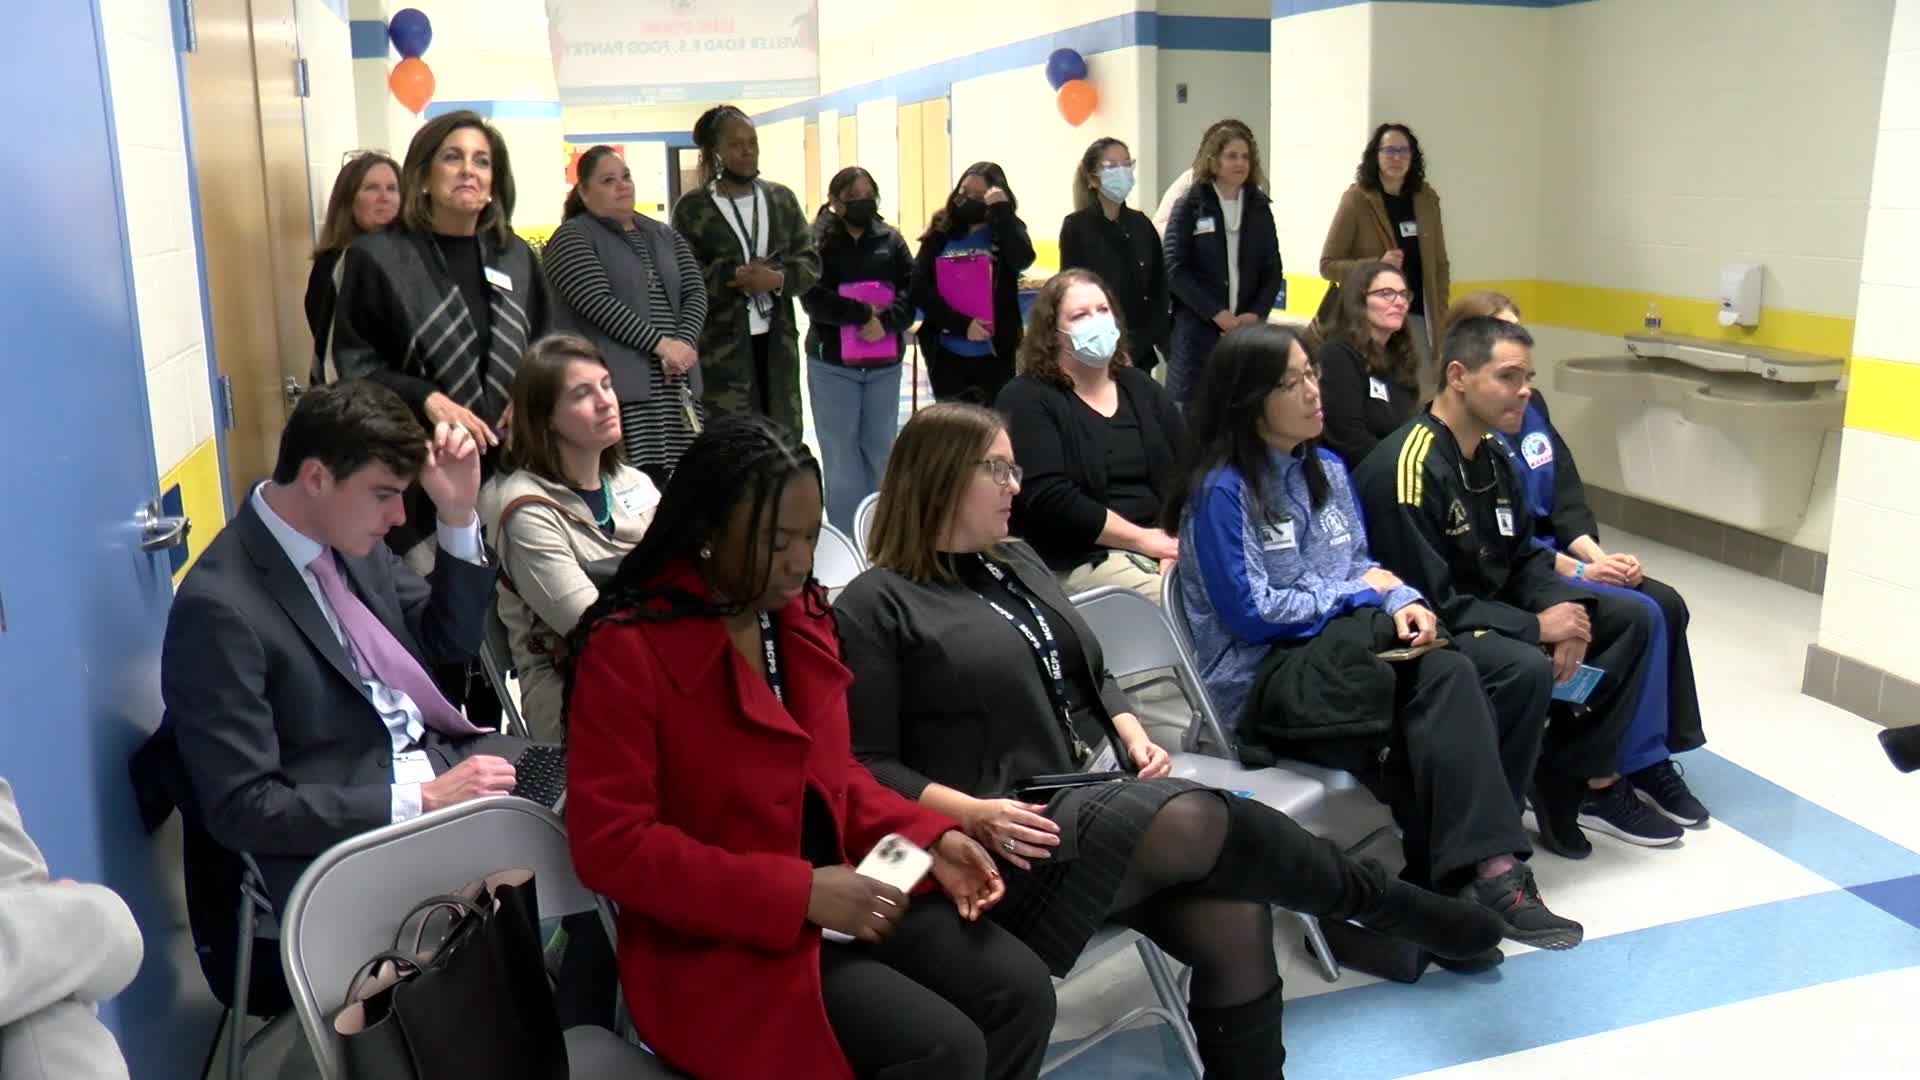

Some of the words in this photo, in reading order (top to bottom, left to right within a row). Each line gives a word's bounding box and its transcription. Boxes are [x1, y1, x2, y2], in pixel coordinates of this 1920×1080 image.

[1018, 623, 1041, 649] MCPS
[764, 639, 777, 674] MCPS
[1049, 649, 1063, 680] MCPS
